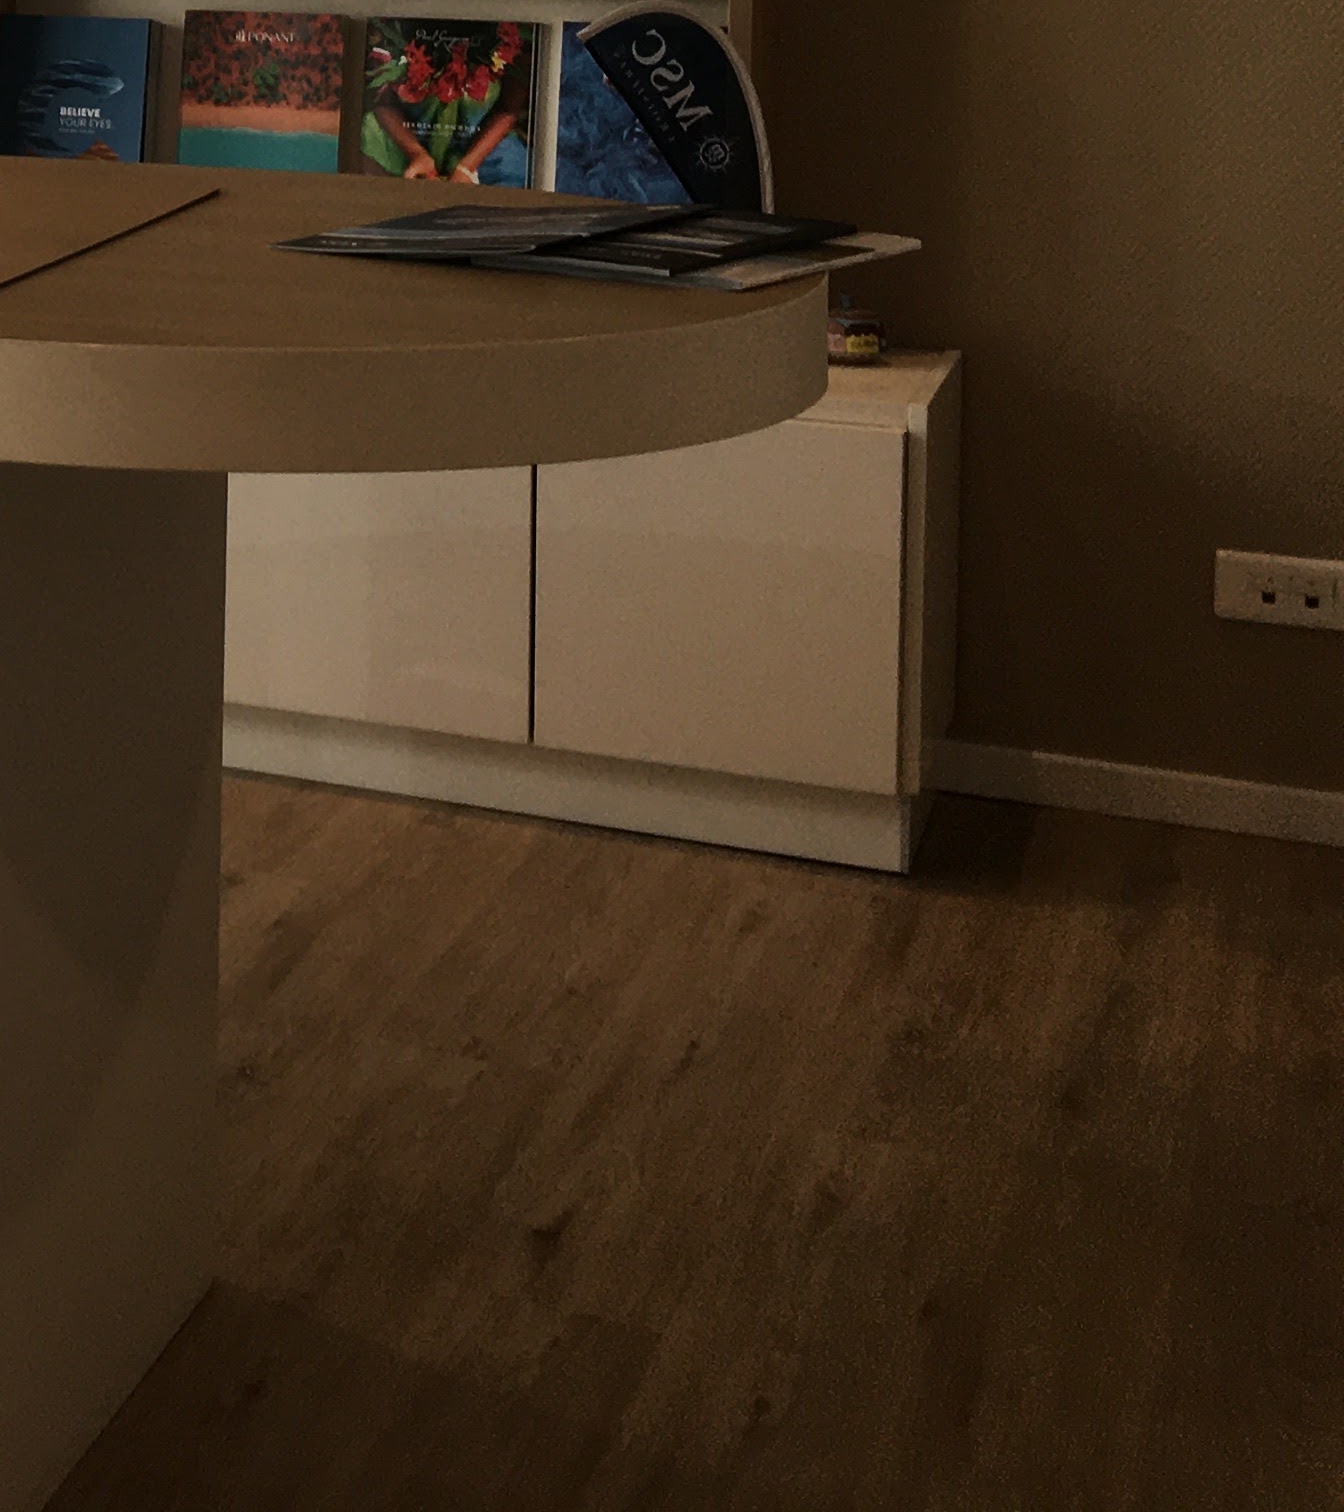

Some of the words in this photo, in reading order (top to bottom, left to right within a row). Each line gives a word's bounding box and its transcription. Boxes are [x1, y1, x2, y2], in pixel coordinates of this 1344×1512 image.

[248, 31, 295, 43] PONANT
[60, 106, 101, 119] BELIEVE
[60, 118, 87, 128] YOUR
[89, 118, 111, 130] EYES
